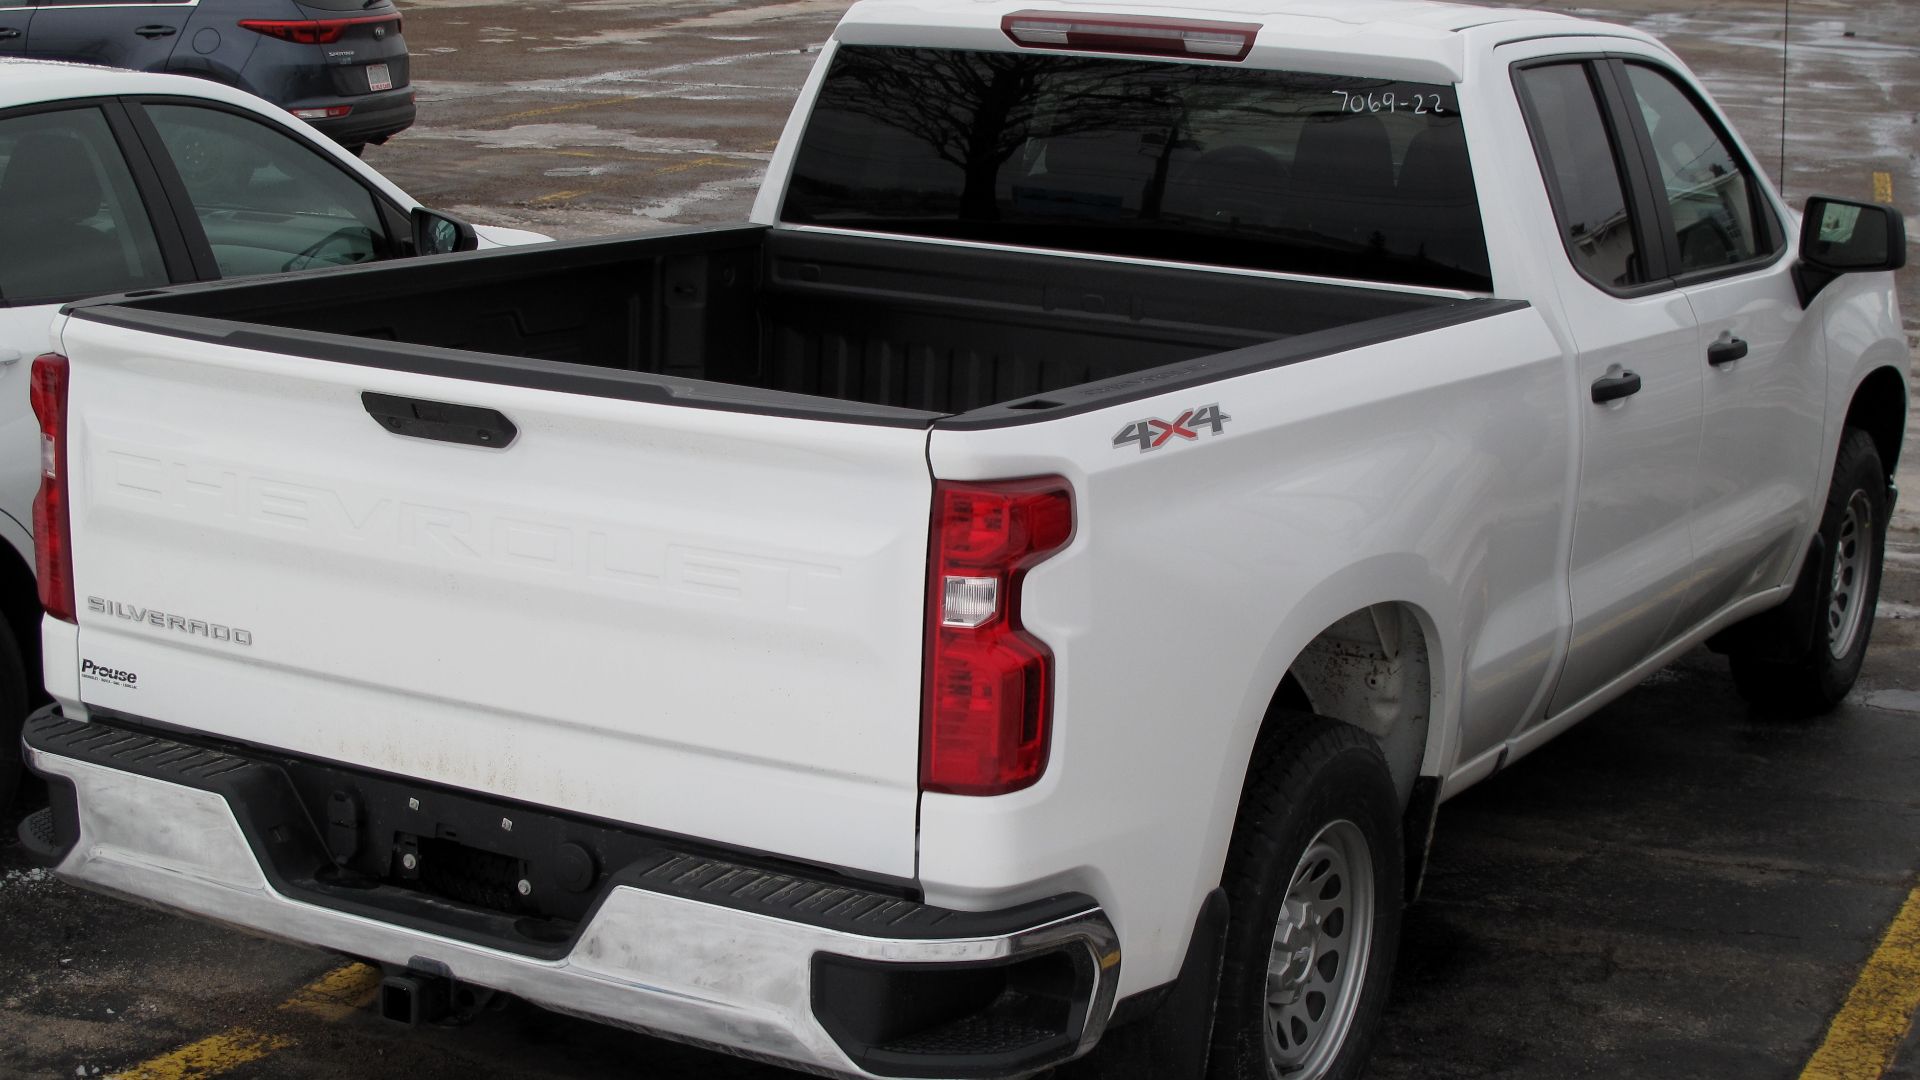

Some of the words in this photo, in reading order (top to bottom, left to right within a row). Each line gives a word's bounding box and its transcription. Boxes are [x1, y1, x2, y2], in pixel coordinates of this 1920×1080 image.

[1331, 90, 1445, 115] 7069-22
[103, 446, 845, 613] CHEVROLET
[87, 595, 253, 646] SILVERADO
[81, 658, 138, 684] Prouse
